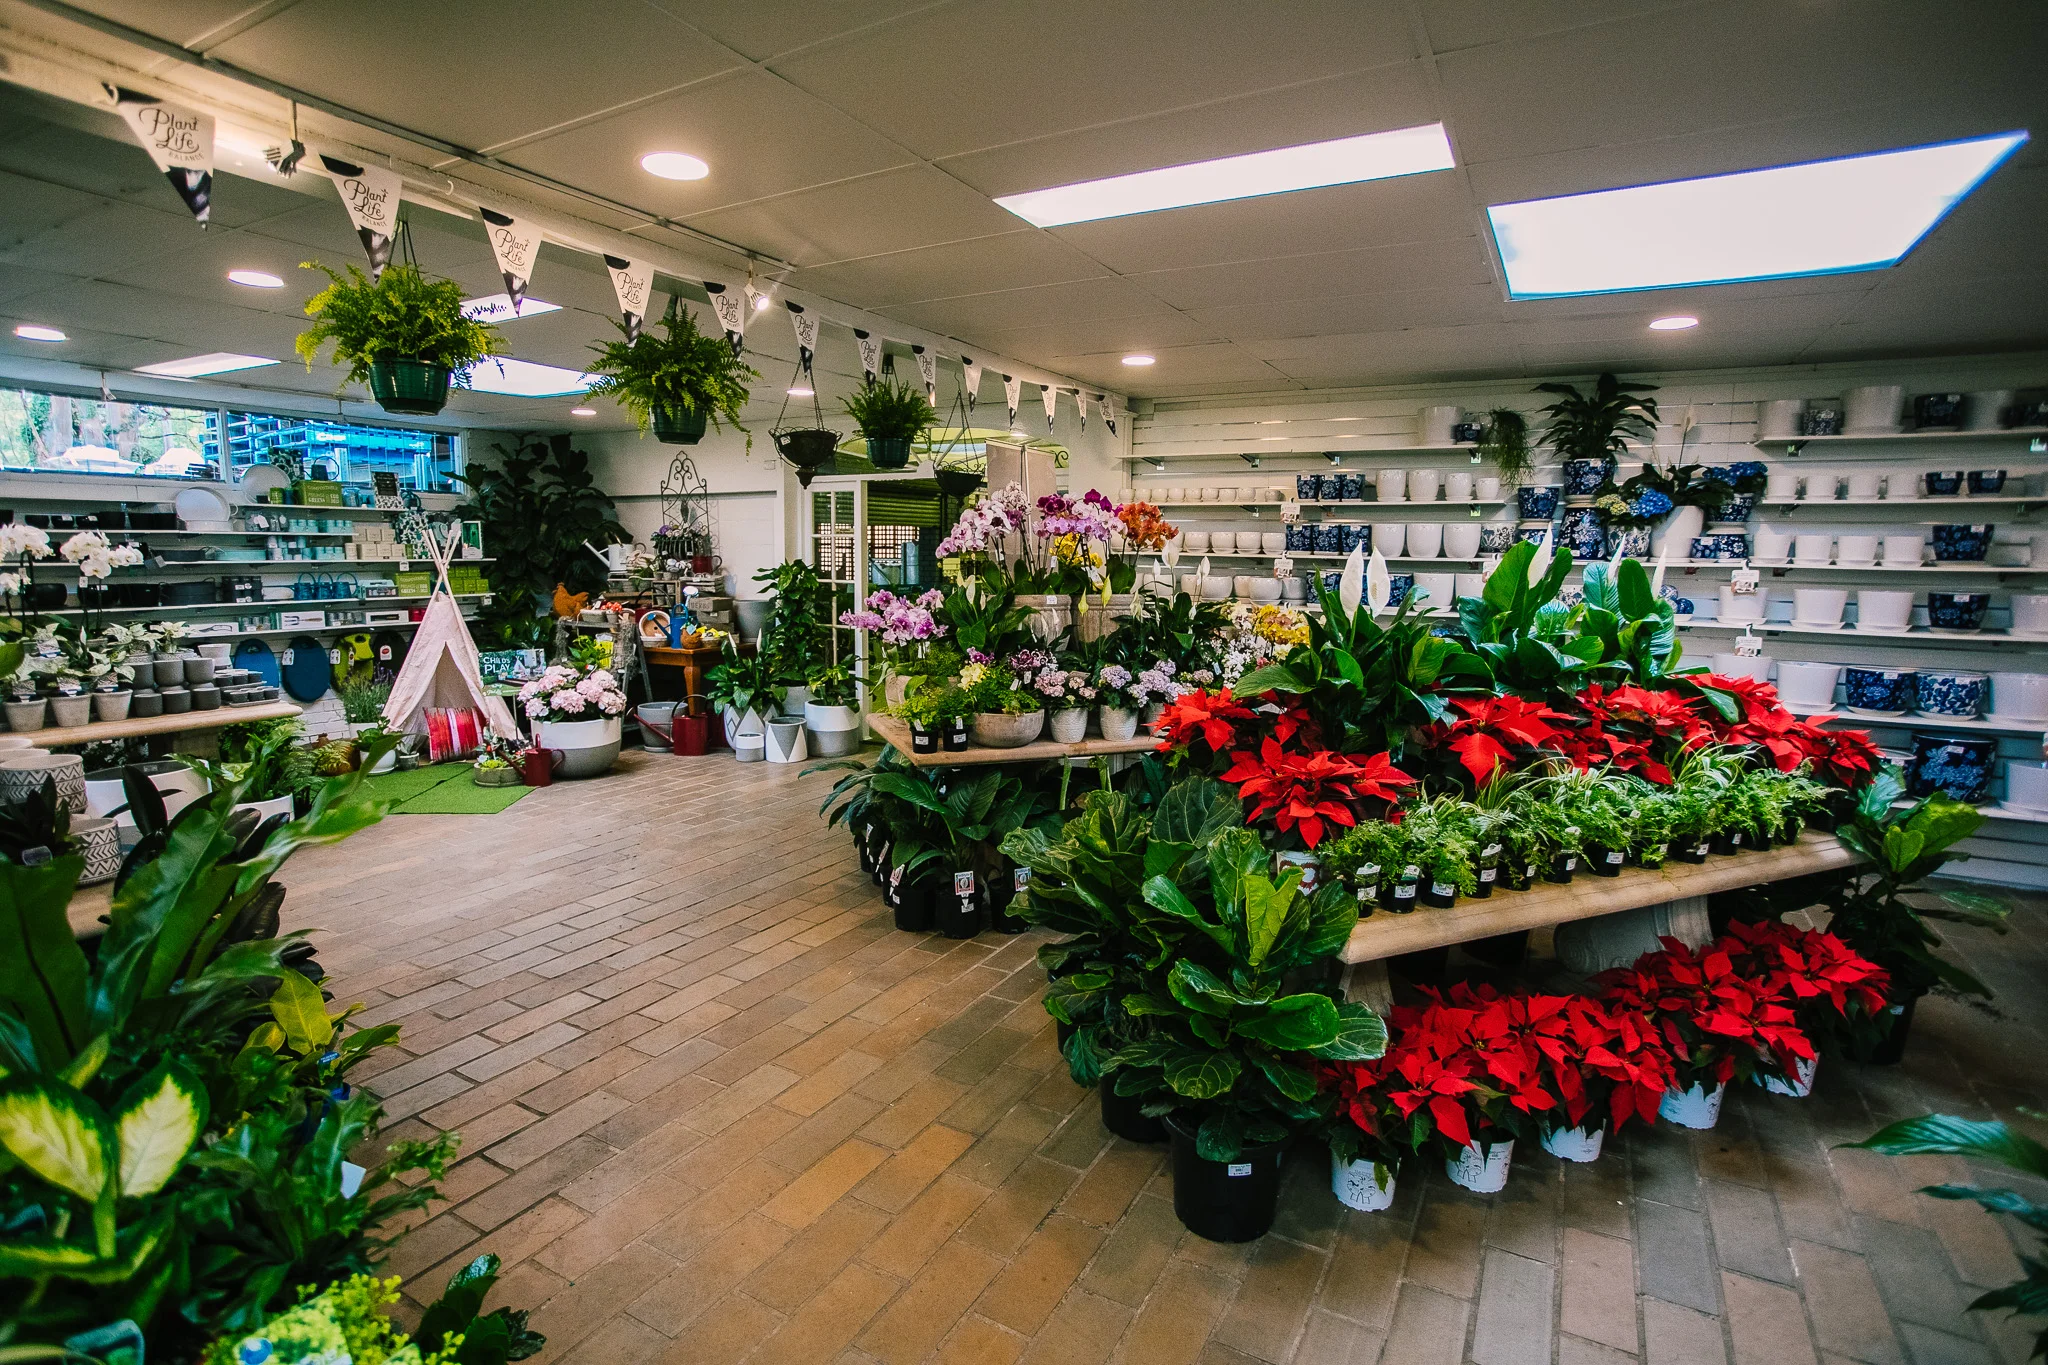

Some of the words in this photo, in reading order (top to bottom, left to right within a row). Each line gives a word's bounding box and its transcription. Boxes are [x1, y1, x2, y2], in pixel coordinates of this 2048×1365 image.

[139, 107, 199, 135] Plant
[154, 127, 199, 154] Life
[343, 178, 389, 203] Plant
[352, 197, 385, 220] Life
[494, 228, 531, 252] Plant
[500, 245, 525, 267] Life
[616, 271, 645, 290] Plant
[621, 285, 642, 305] Life
[484, 663, 511, 674] PLAY
